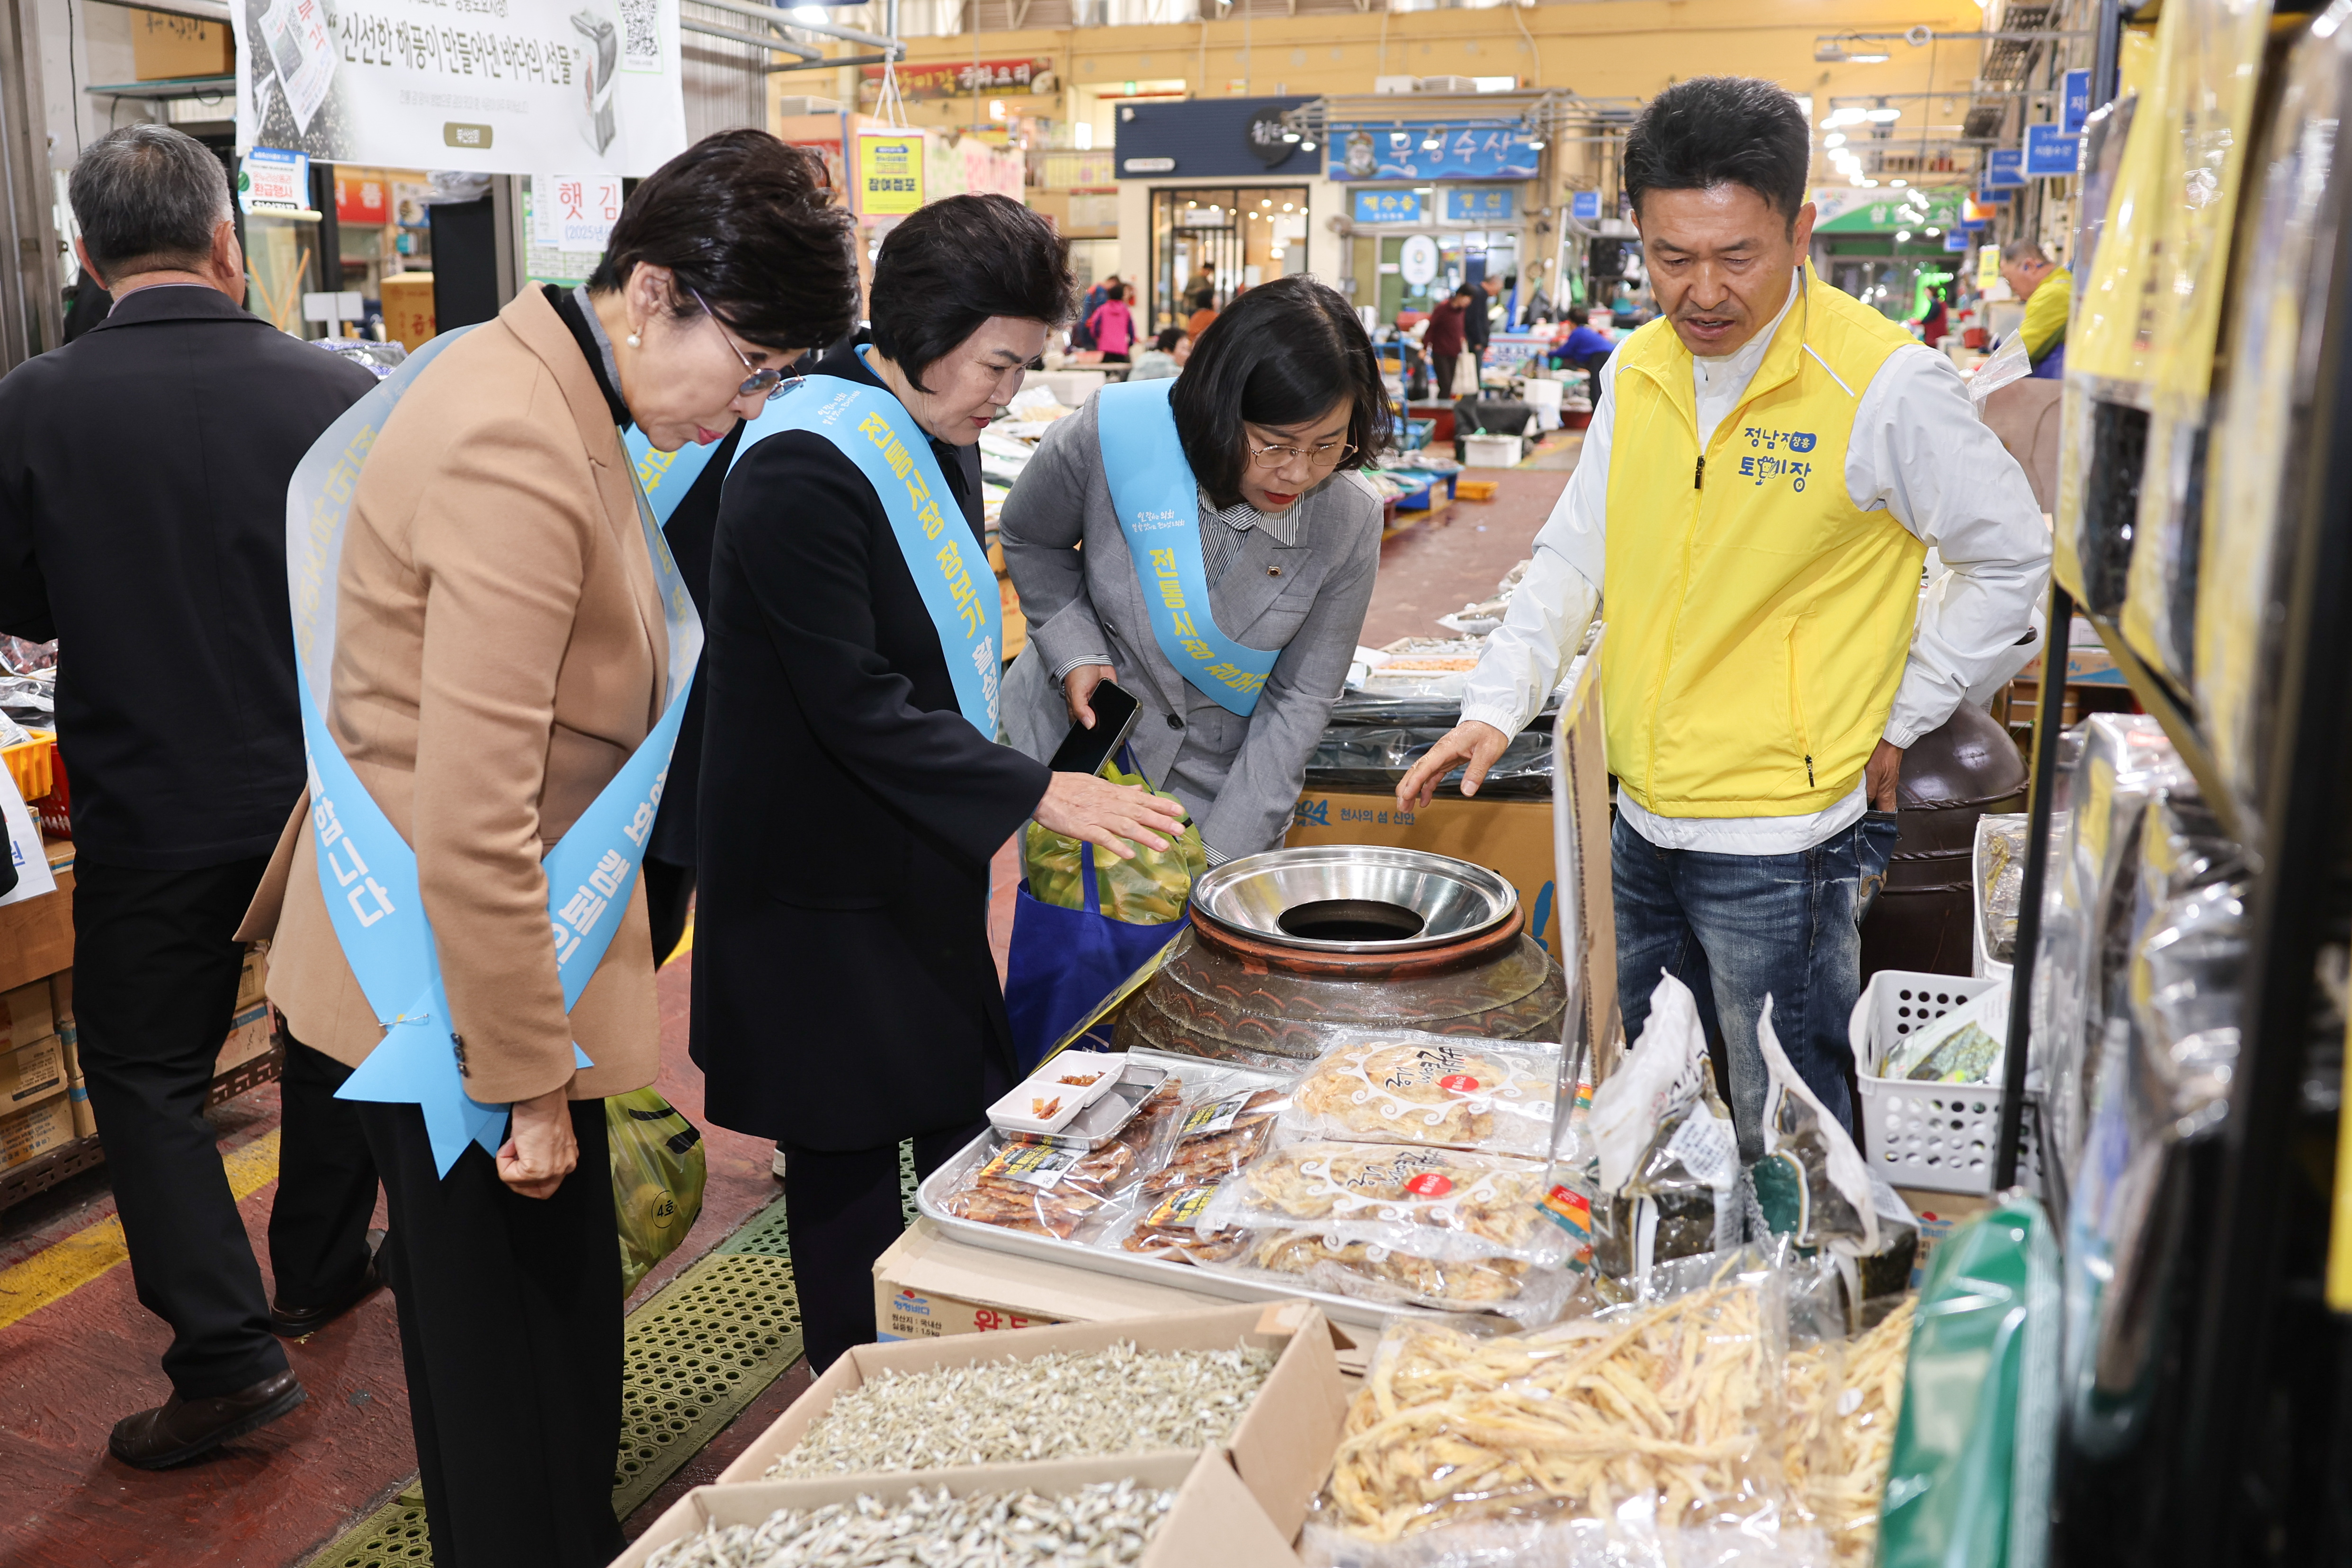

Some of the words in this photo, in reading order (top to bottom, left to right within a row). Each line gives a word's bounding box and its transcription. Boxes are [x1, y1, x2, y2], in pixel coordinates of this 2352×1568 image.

[396, 20, 443, 72] 해풍이
[441, 26, 501, 78] 만들어낸
[499, 35, 545, 83] 바다의
[254, 183, 293, 198] 환급행사
[868, 178, 915, 192] 참여점포
[1792, 436, 1811, 449] 장흥
[1161, 509, 1174, 520] 의회
[858, 411, 946, 541] 전통시장
[936, 539, 986, 639] 장보기
[971, 636, 1001, 729] 활성화
[1149, 547, 1215, 660] 전통시장
[1341, 808, 1373, 823] 천사의
[1377, 811, 1388, 824] 섬
[1393, 812, 1415, 825] 신안
[1451, 1076, 1467, 1090] 건어물
[1418, 1175, 1440, 1193] 건어물
[657, 1199, 674, 1218] 4호
[893, 1300, 930, 1316] 청정바다
[892, 1313, 913, 1325] 원산지
[920, 1319, 942, 1330] 국내산
[892, 1321, 914, 1334] 실중량
